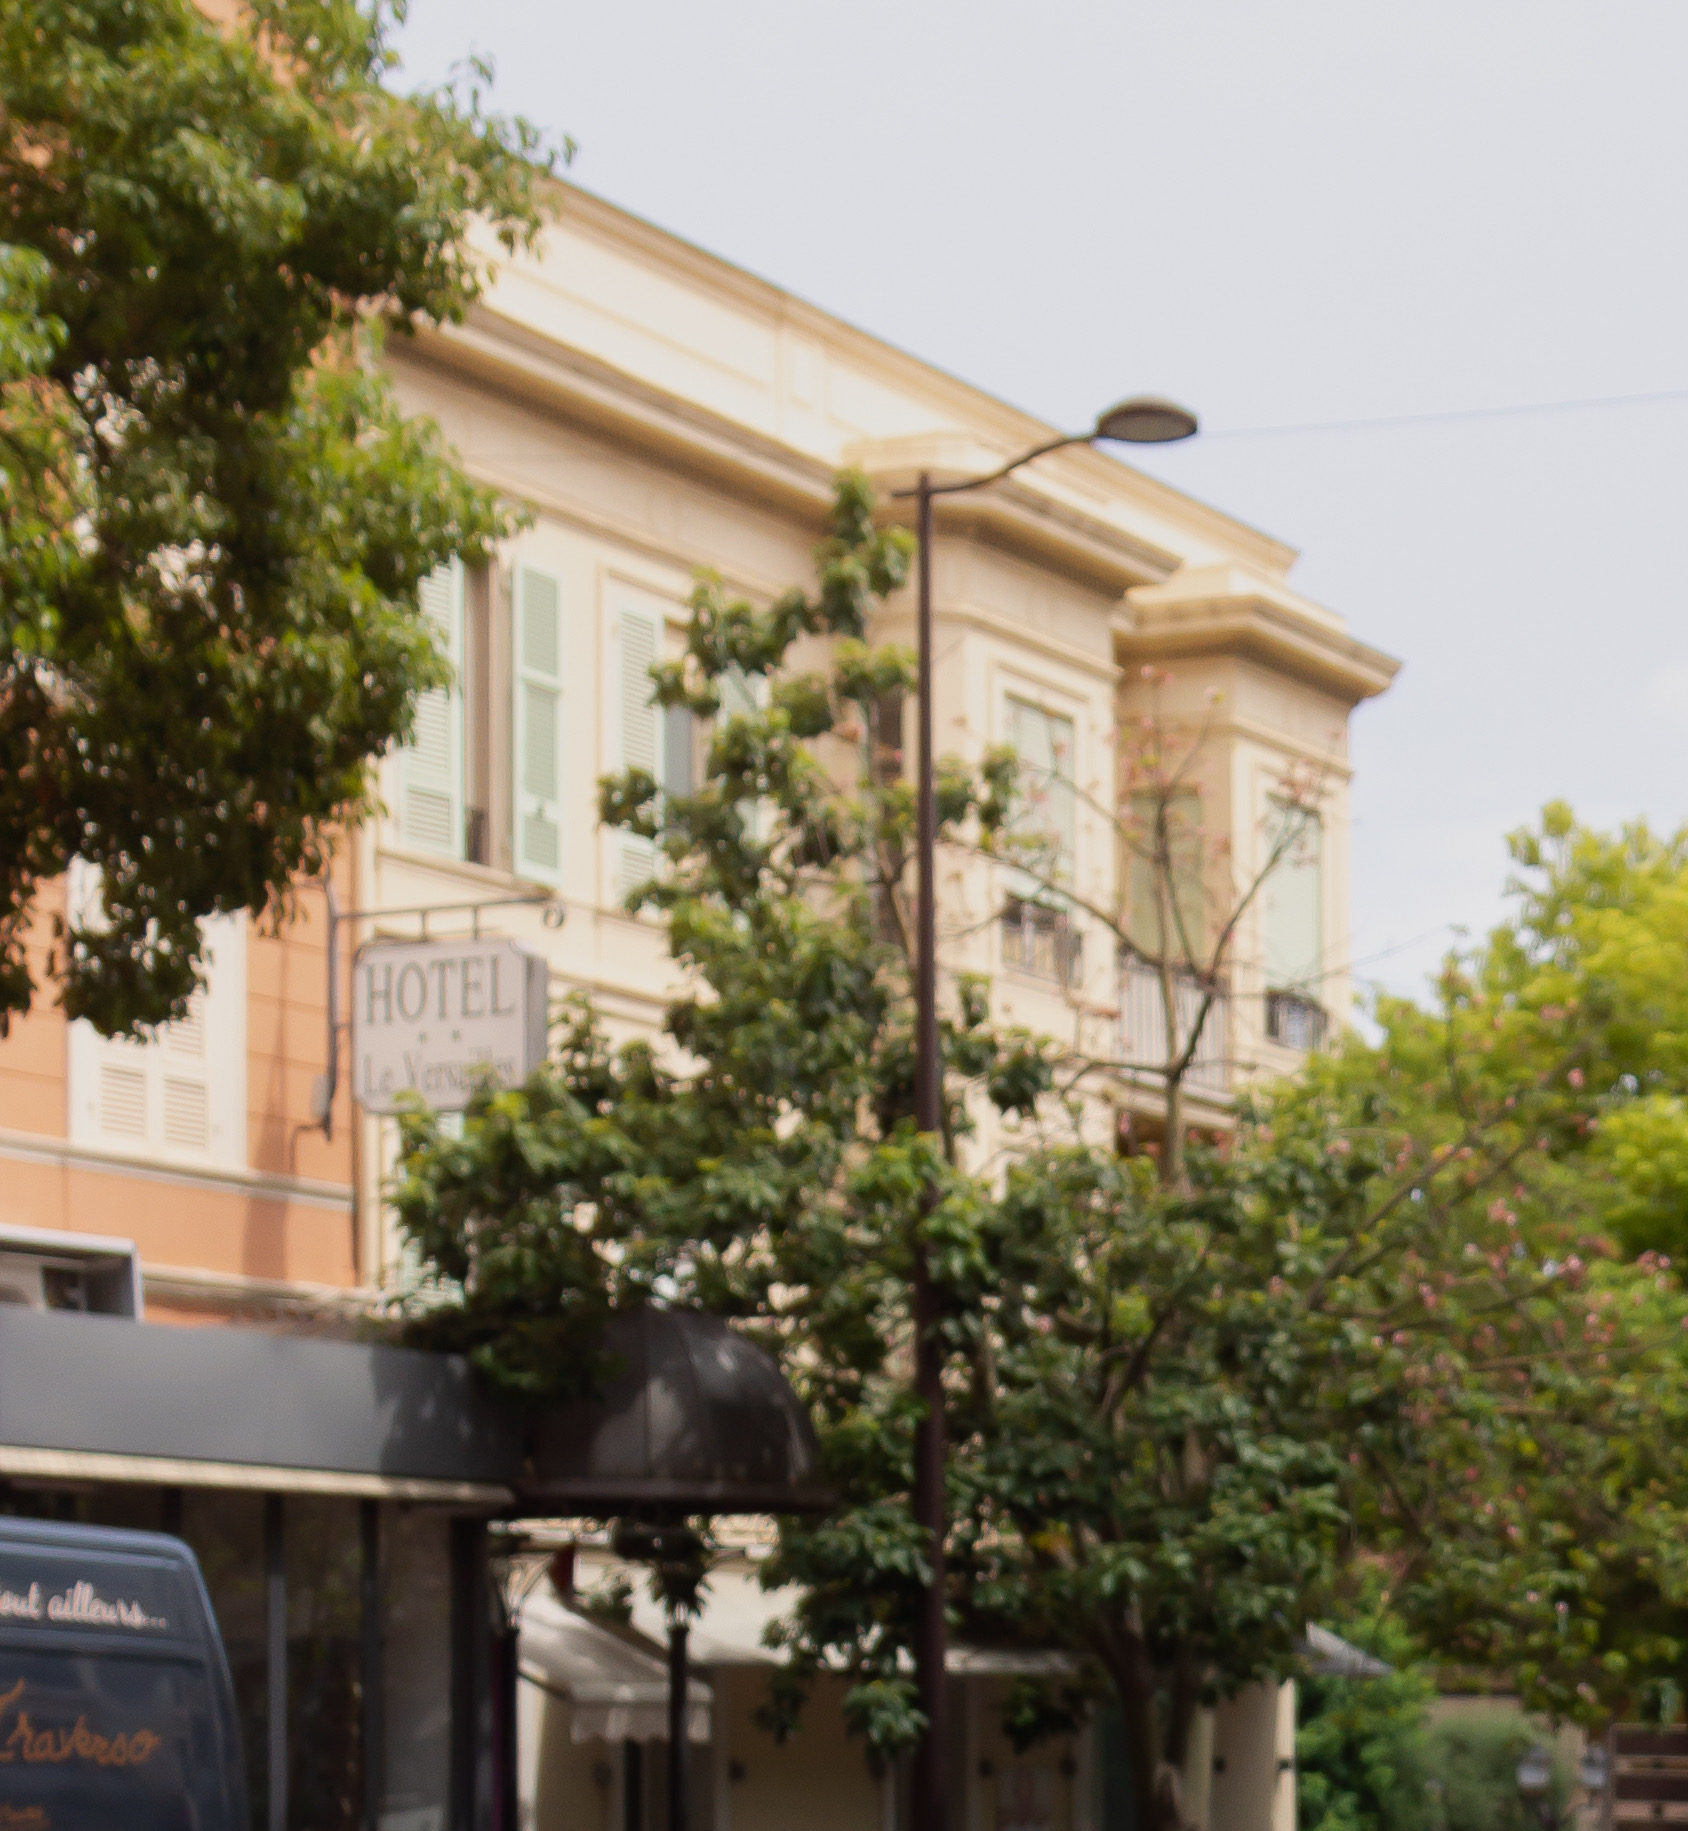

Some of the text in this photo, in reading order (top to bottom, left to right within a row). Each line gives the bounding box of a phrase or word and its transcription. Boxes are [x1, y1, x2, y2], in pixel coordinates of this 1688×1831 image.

[365, 954, 515, 1025] HOTEL
[363, 1054, 392, 1094] Le
[0, 1581, 42, 1620] out
